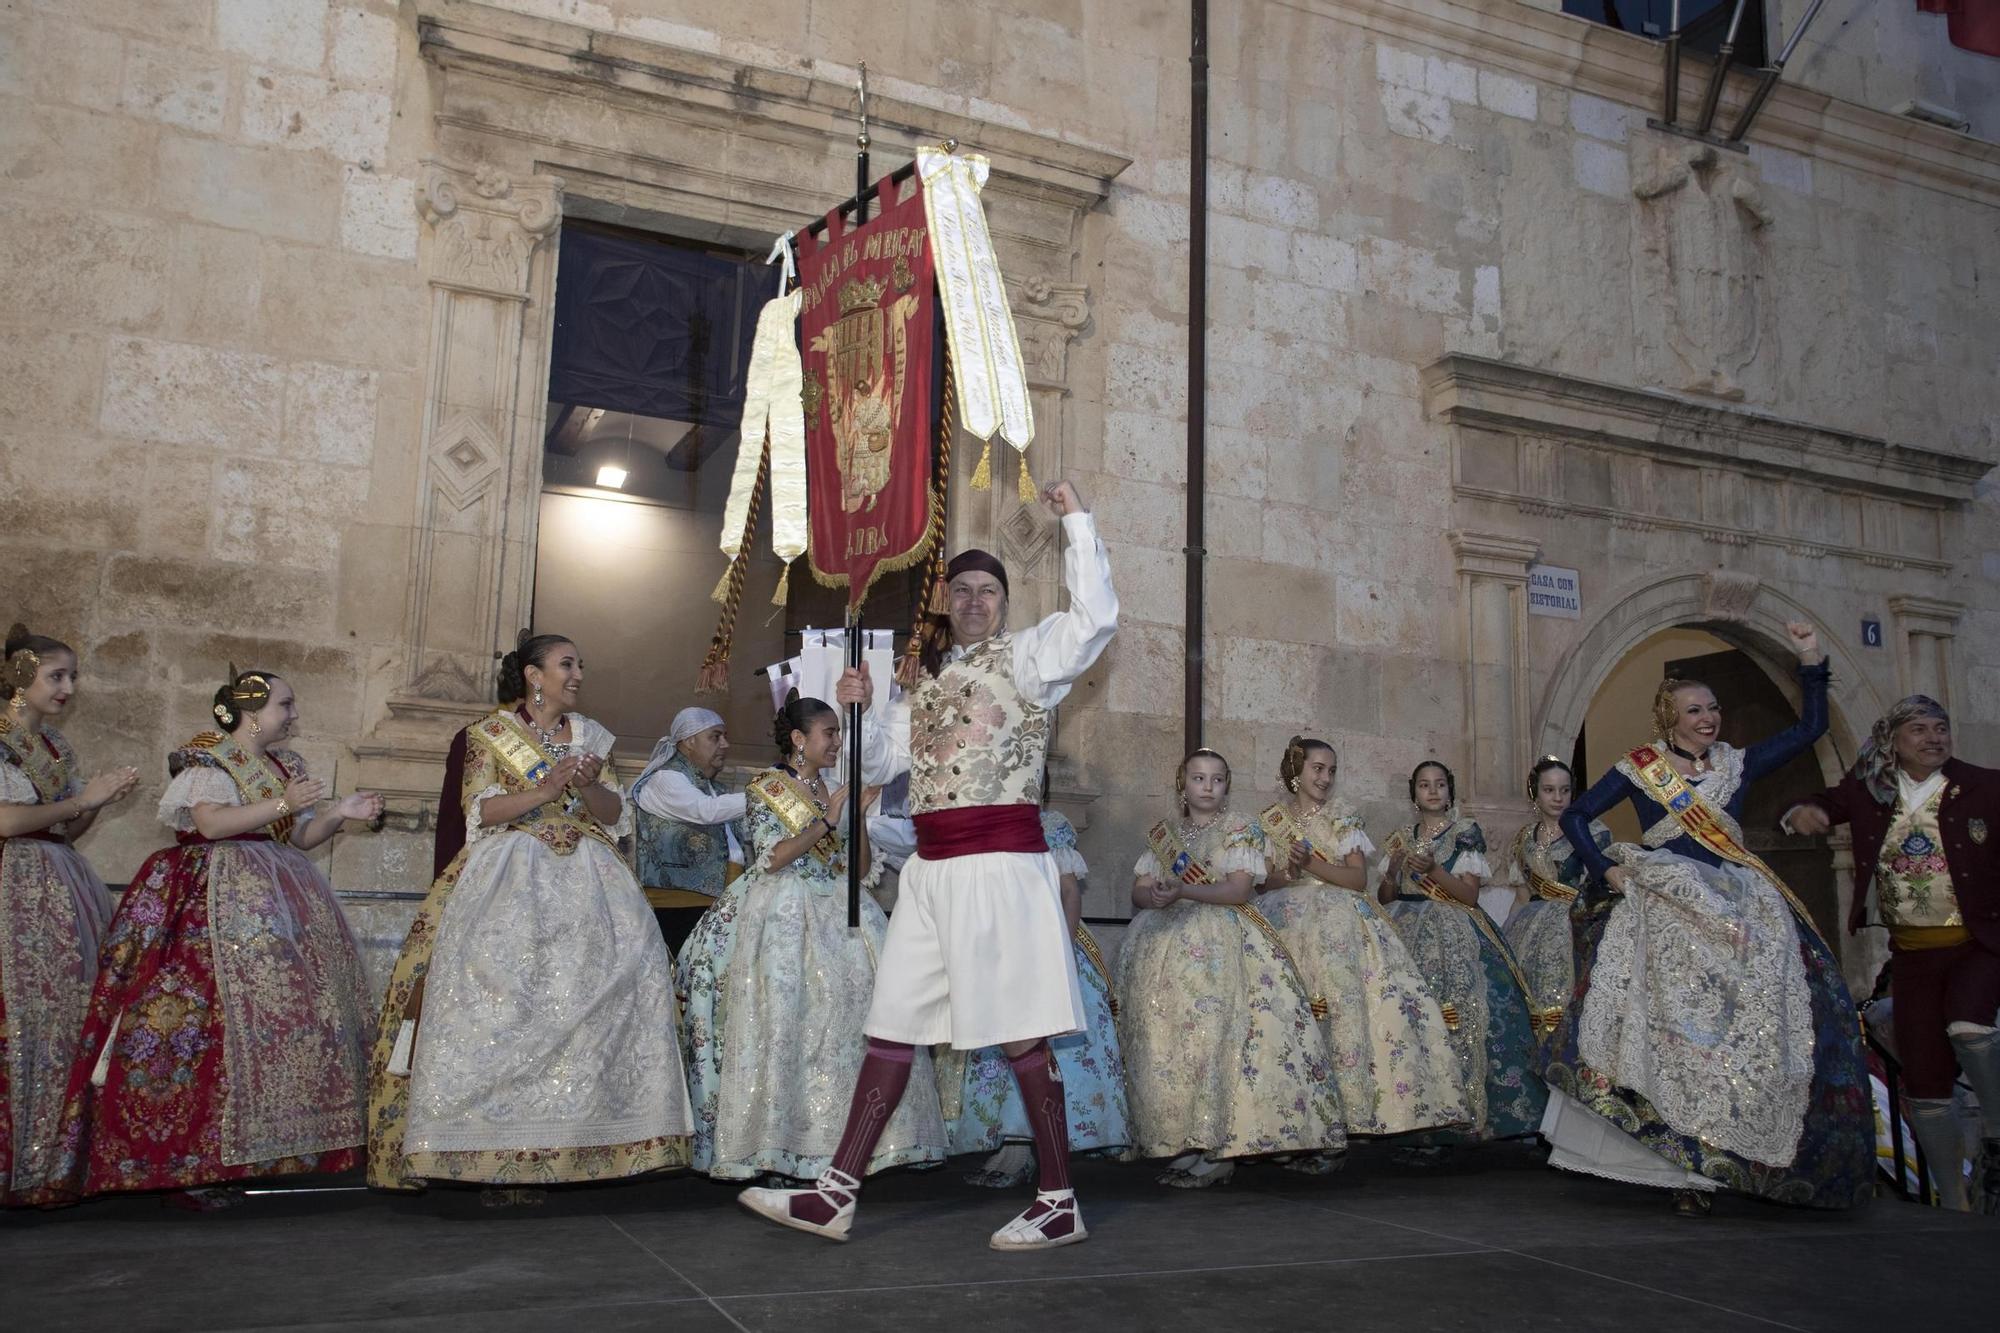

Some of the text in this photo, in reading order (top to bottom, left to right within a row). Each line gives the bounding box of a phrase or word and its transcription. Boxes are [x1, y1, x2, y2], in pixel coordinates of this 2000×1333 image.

[801, 254, 840, 314] FALLA
[1531, 573, 1574, 592] CASA CON
[1530, 592, 1578, 610] SISTORIAL
[1867, 623, 1876, 645] 6
[1663, 783, 1682, 799] 2024
